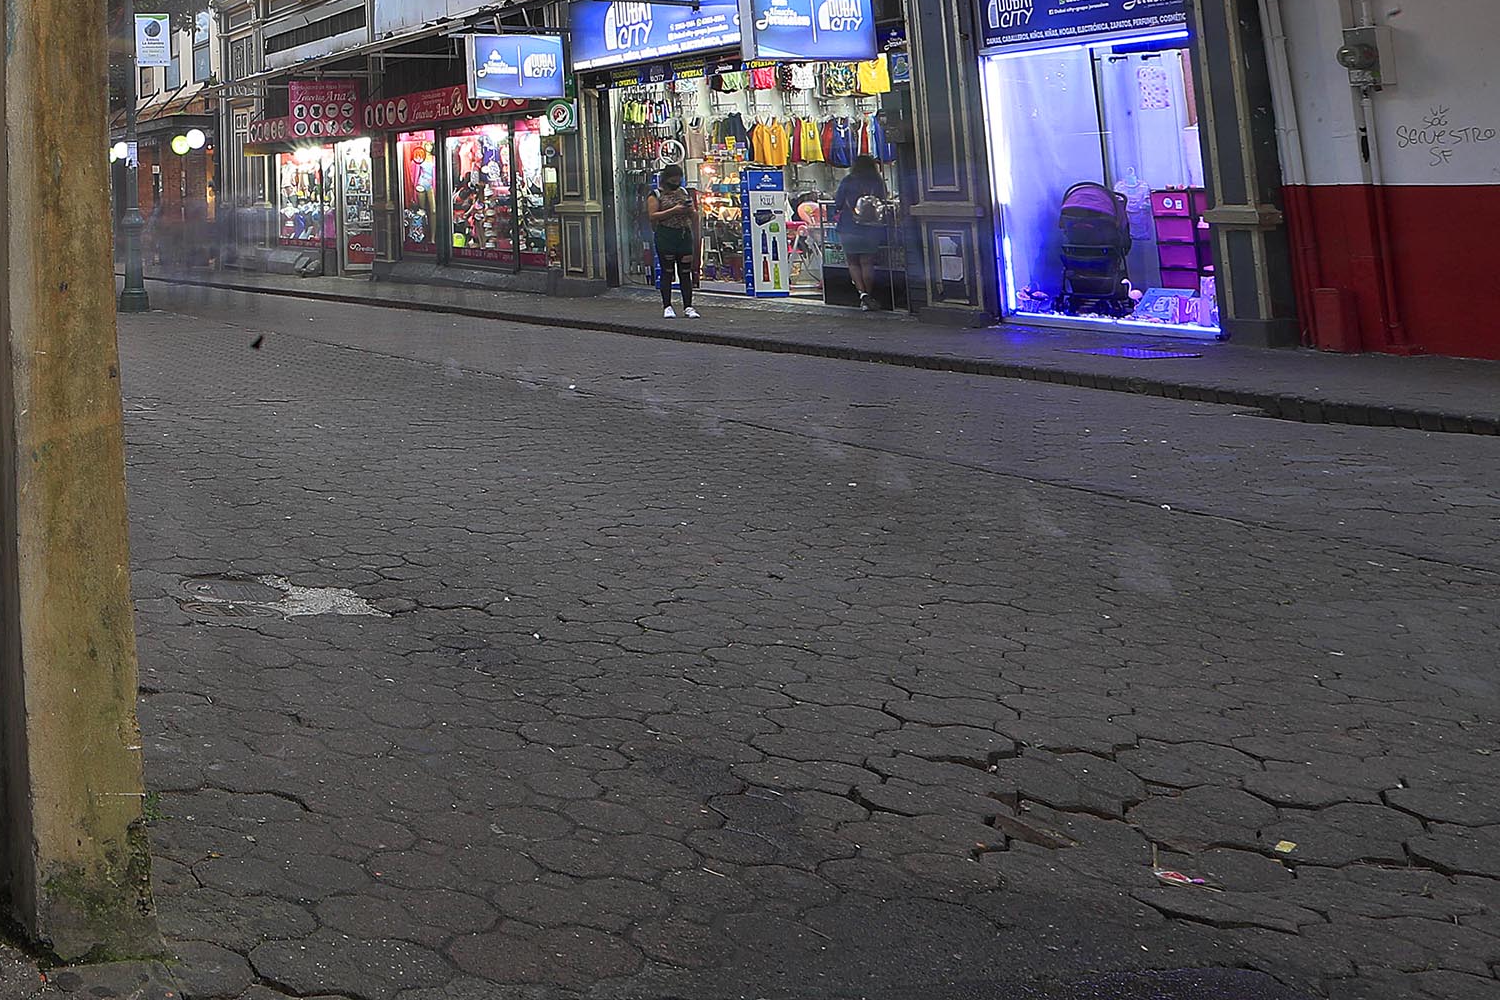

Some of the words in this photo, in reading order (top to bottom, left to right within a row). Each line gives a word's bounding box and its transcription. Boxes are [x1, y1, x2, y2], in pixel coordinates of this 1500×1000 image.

[831, 16, 864, 31] CITY
[1000, 7, 1034, 28] CITY
[618, 18, 654, 50] CITY
[532, 67, 557, 78] CITY
